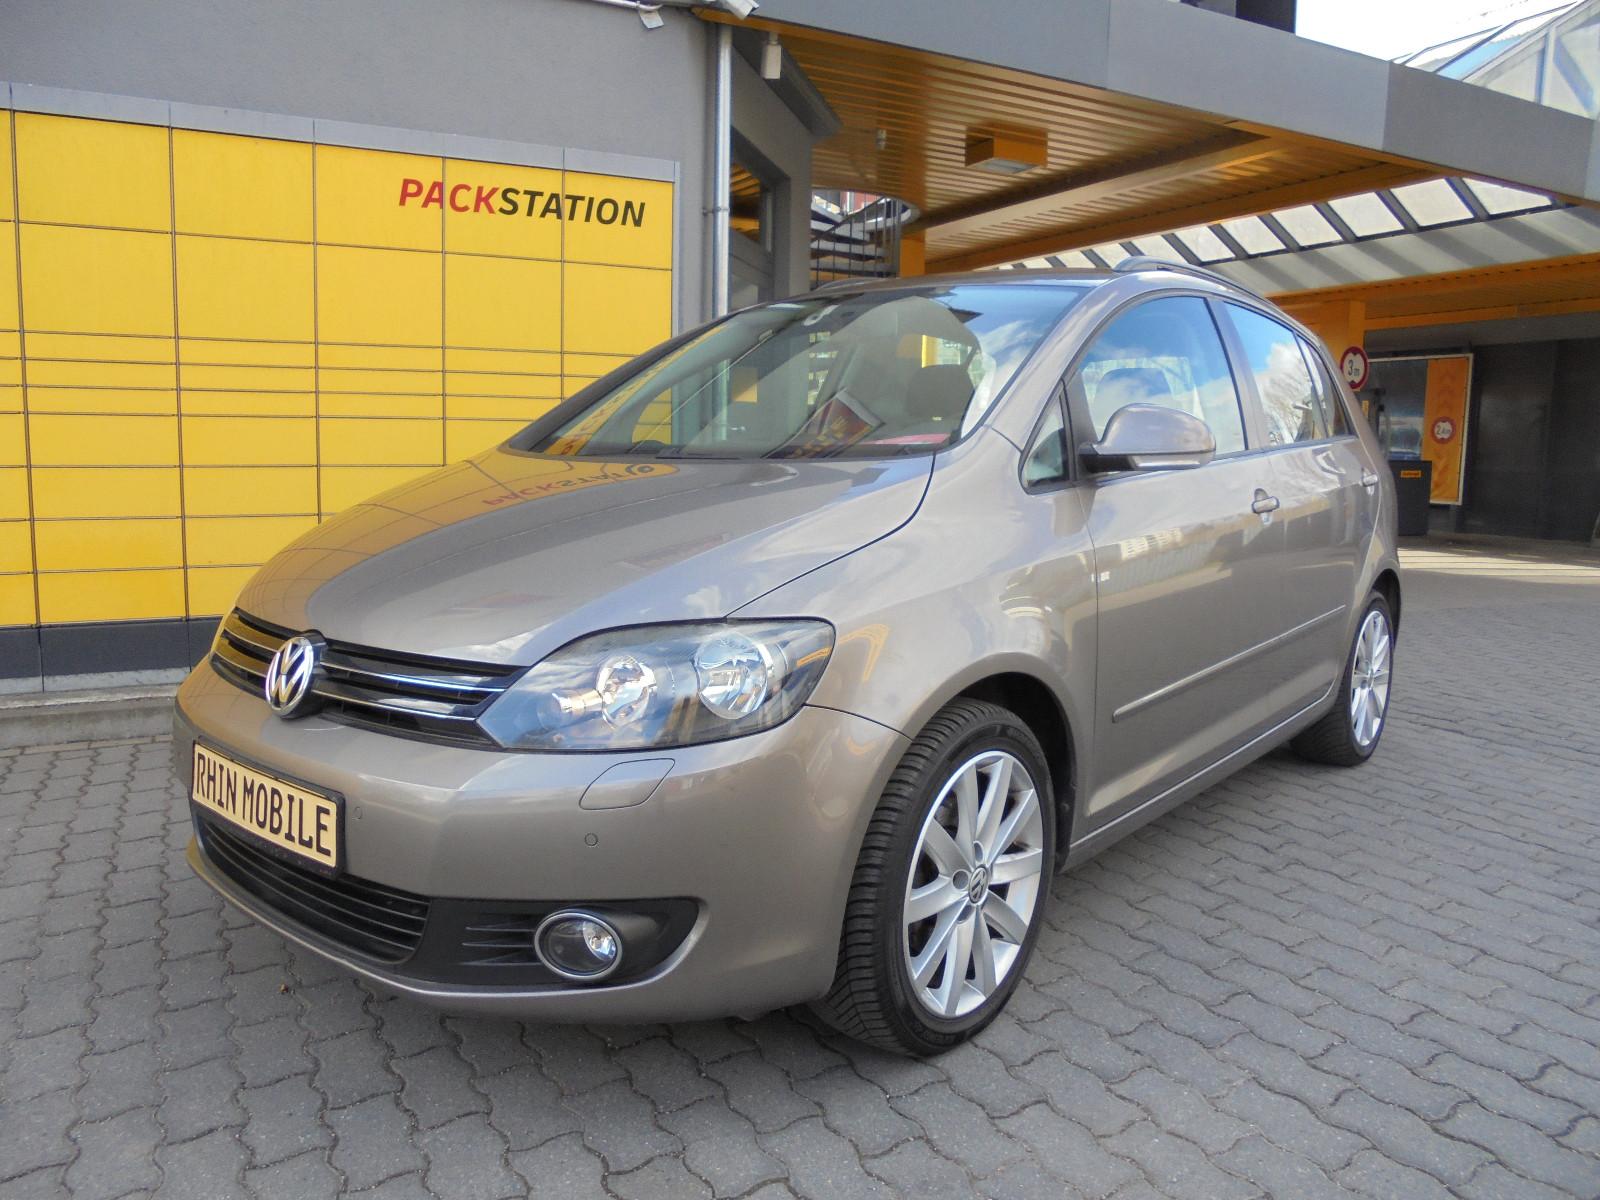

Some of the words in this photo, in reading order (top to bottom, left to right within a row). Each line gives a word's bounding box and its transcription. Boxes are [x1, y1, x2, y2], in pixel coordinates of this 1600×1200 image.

[398, 178, 646, 228] PACKSTATION
[1348, 359, 1354, 376] 3
[1353, 368, 1360, 376] m
[196, 751, 237, 815] RHIN
[242, 775, 332, 857] MOBILE
